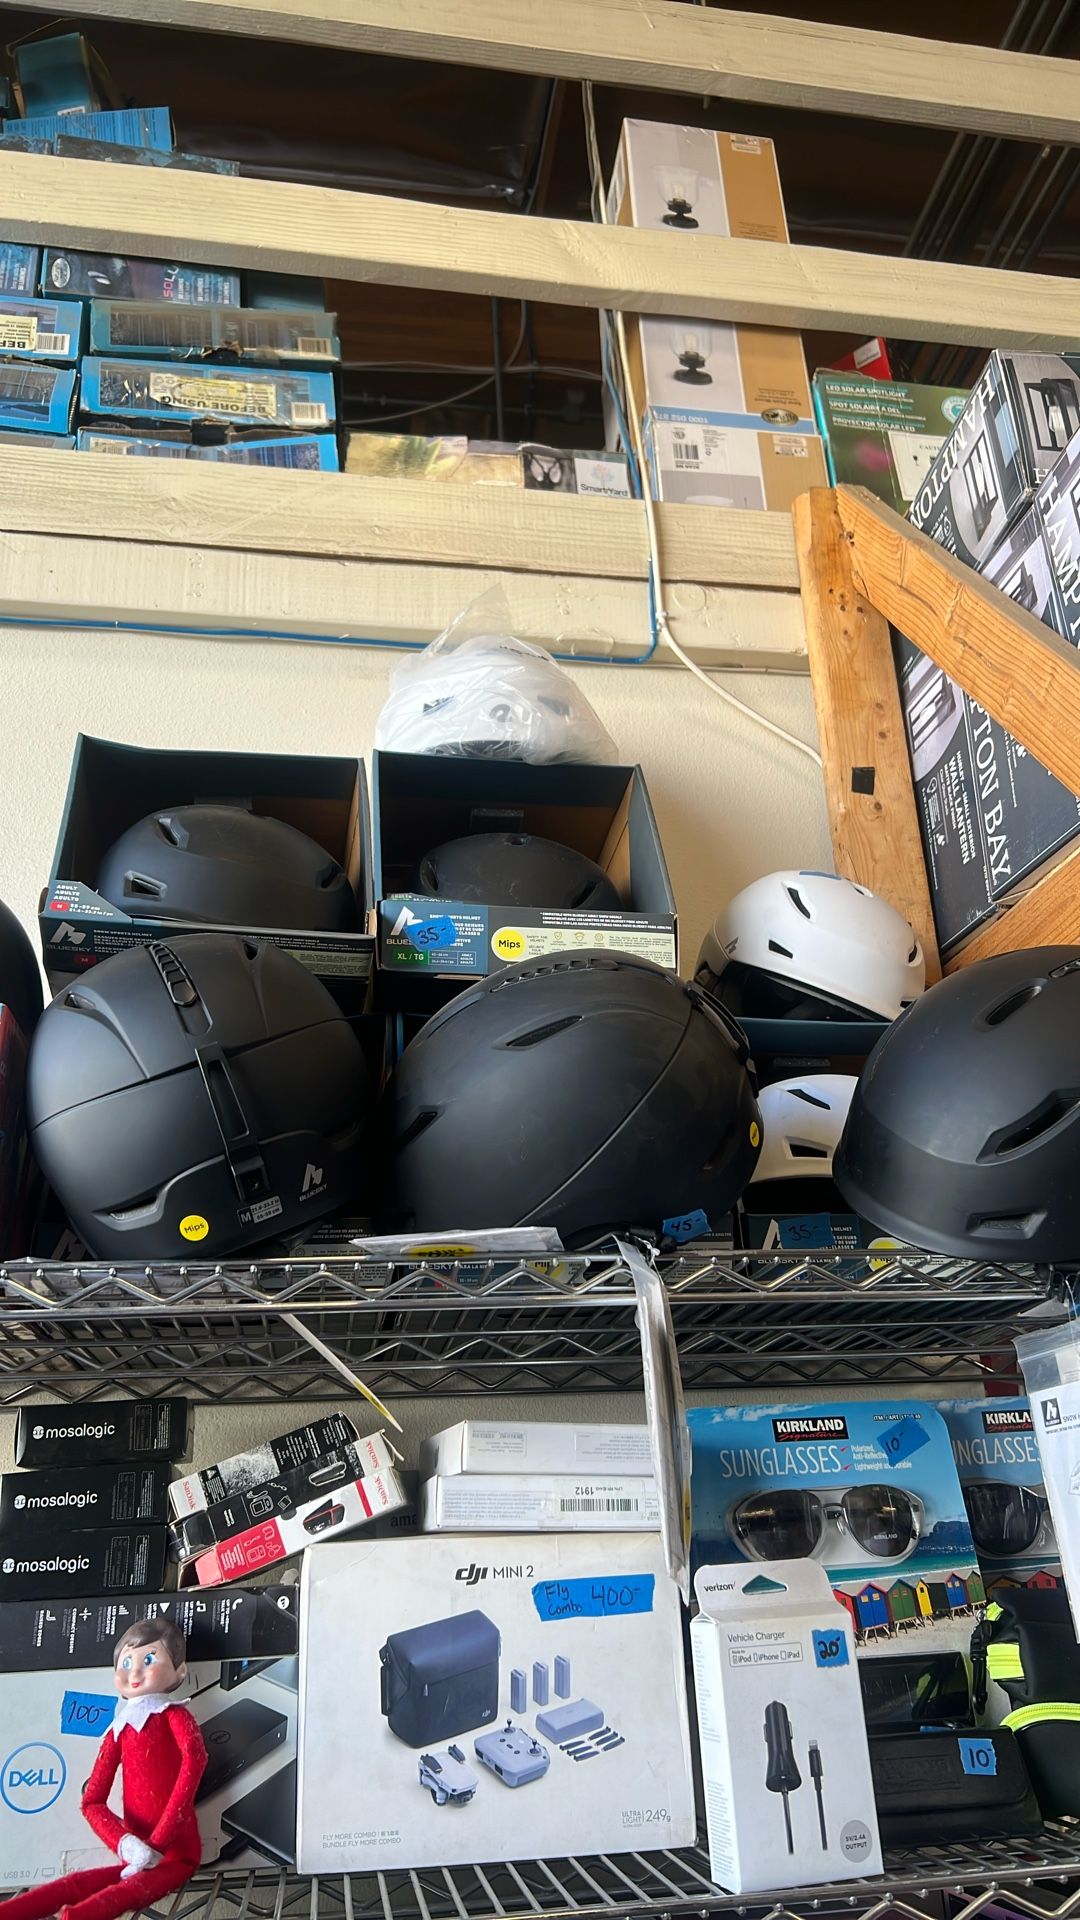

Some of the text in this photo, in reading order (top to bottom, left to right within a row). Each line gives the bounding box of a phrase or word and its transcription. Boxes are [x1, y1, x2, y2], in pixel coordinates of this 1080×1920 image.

[825, 384, 841, 392] LED
[841, 386, 866, 394] SOLAR
[866, 388, 906, 398] SPOTLIGHT
[210, 401, 266, 413] BEFORE
[828, 400, 848, 409] SPOT
[832, 416, 876, 427] PROYECTOR
[908, 368, 996, 530] HAMPTON
[580, 483, 629, 497] SmartYard
[969, 695, 1000, 800] PTON
[948, 755, 969, 865] WALL LANTERN
[956, 750, 976, 859] HURLEY SMALL EXTERIOR
[984, 799, 1011, 881] BAY
[498, 939, 521, 949] Mips
[413, 953, 424, 961] TG
[299, 1184, 327, 1202] BLUESKY
[240, 1210, 251, 1223] M
[184, 1222, 205, 1234] Mips
[985, 1411, 1032, 1425] KIRKLA
[45, 1422, 116, 1440] mosalogic
[776, 1419, 844, 1433] KIRKLAND
[366, 1440, 381, 1469] SanDisk
[719, 1445, 843, 1478] SUNGLASSES
[183, 1480, 196, 1510] SanDisk
[575, 1486, 594, 1496] 1912
[26, 1490, 98, 1510] mosalogic
[15, 1555, 90, 1574] mosalogic
[492, 1564, 523, 1579] MINI
[526, 1564, 535, 1578] 2
[544, 1583, 570, 1603] Fly
[703, 1583, 735, 1593] verizon
[727, 1631, 786, 1643] Vehicle Charger
[738, 1651, 800, 1663] iPod iPhone iPad
[8, 1768, 59, 1788] DELL
[621, 1810, 641, 1818] ULTRA
[622, 1816, 641, 1824] LIGHT
[334, 1832, 353, 1840] MORE
[353, 1831, 377, 1839] COMBO
[322, 1840, 347, 1849] BUNDLE
[360, 1838, 377, 1846] MORE
[378, 1837, 401, 1845] COMBO
[845, 1841, 867, 1850] OUTPUT
[3, 1869, 31, 1879] USB 3.0
